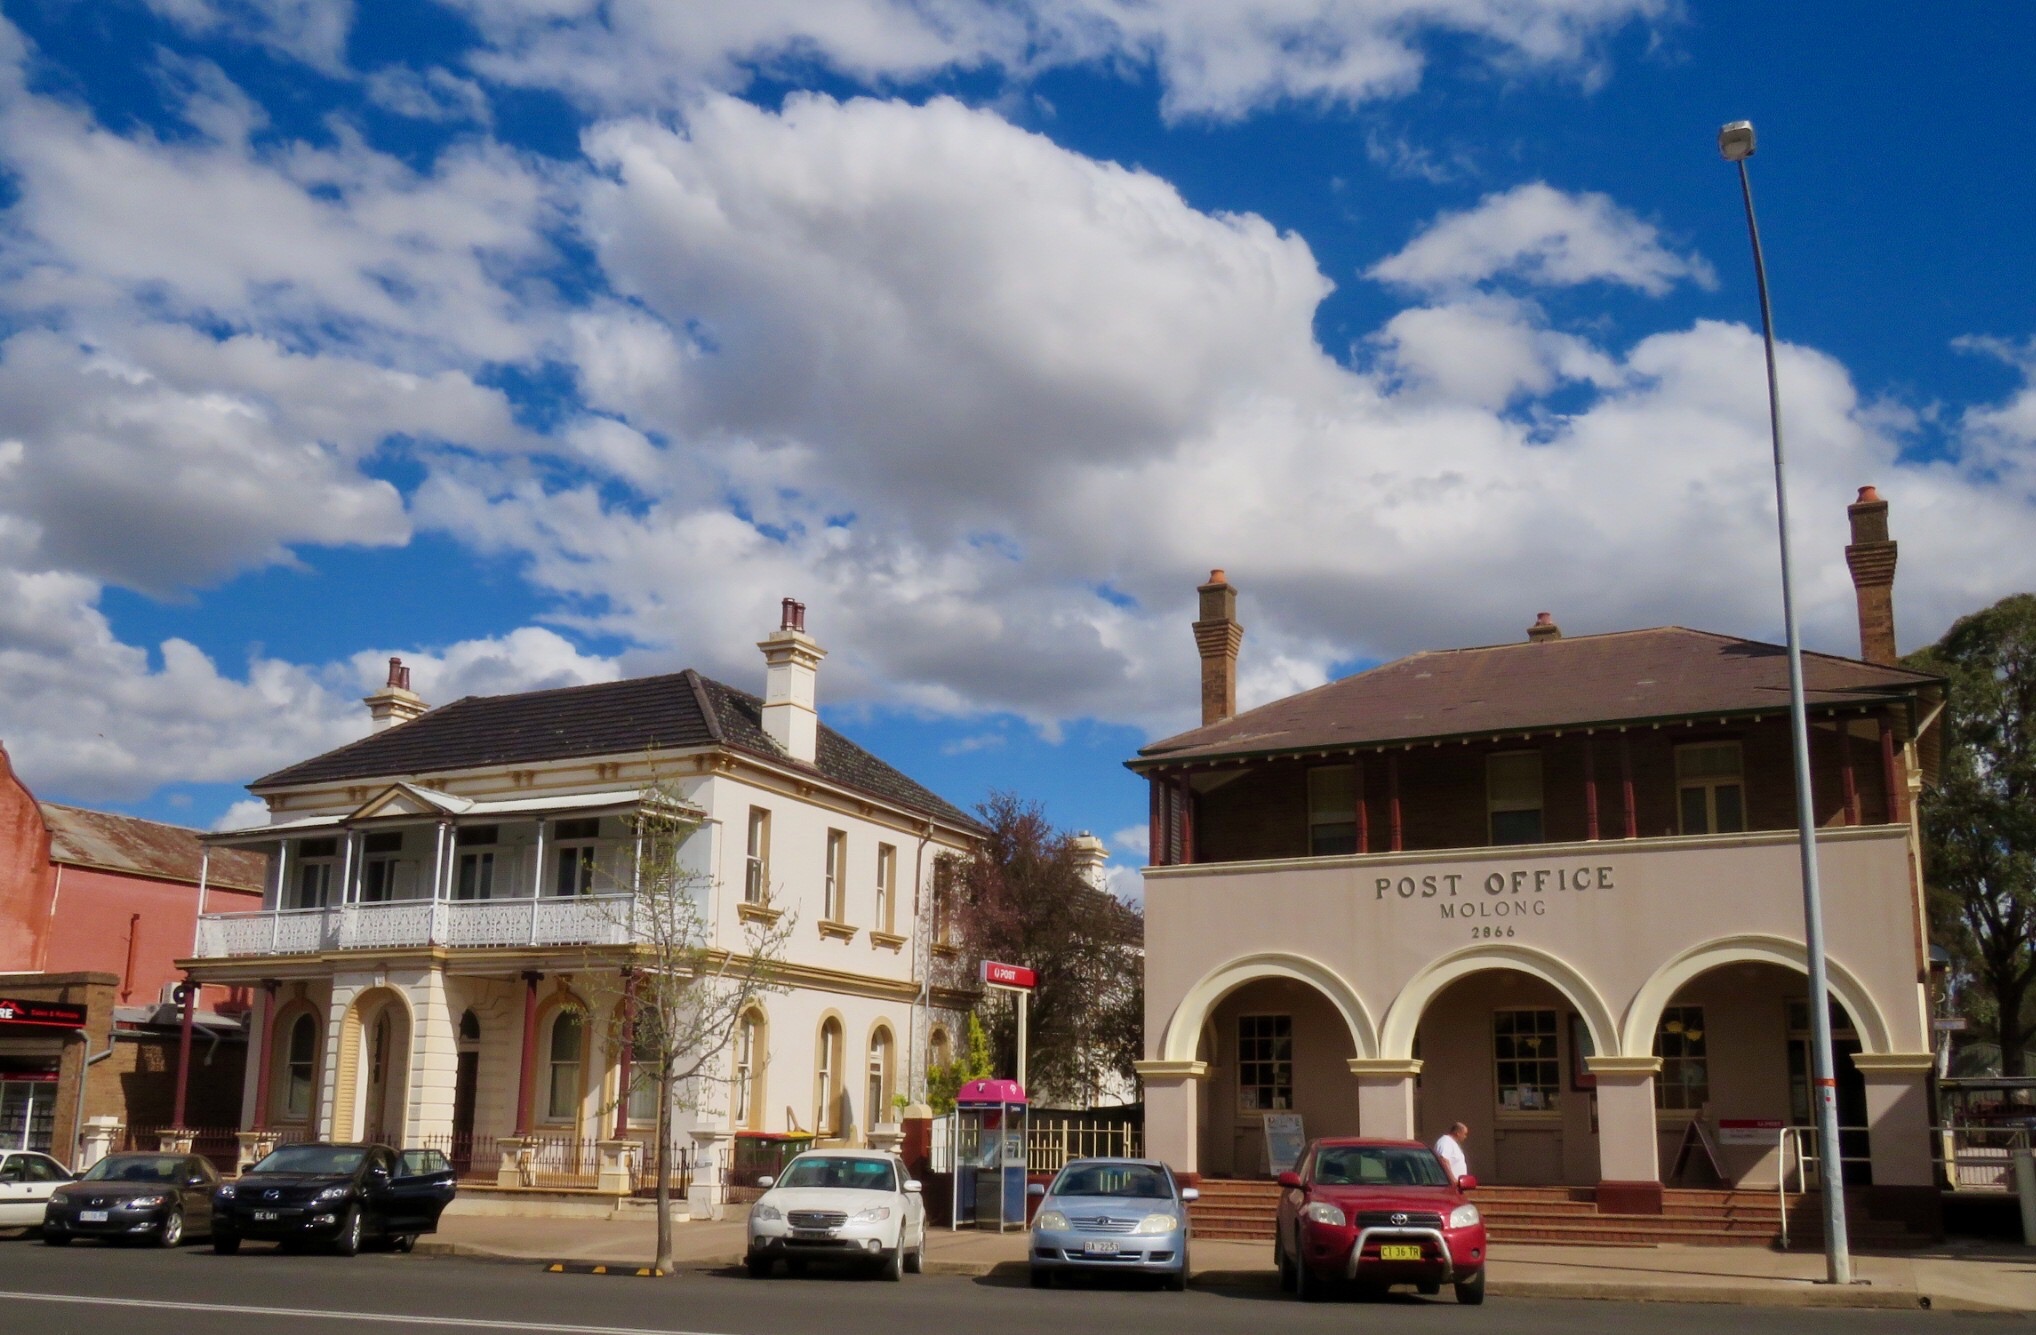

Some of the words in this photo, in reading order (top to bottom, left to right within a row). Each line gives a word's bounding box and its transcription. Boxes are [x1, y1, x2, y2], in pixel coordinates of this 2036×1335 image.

[1375, 874, 1462, 899] POST
[1484, 866, 1614, 896] OFFICE
[1440, 900, 1546, 919] MOLONG
[1471, 926, 1515, 939] 2866
[1000, 969, 1016, 980] POST
